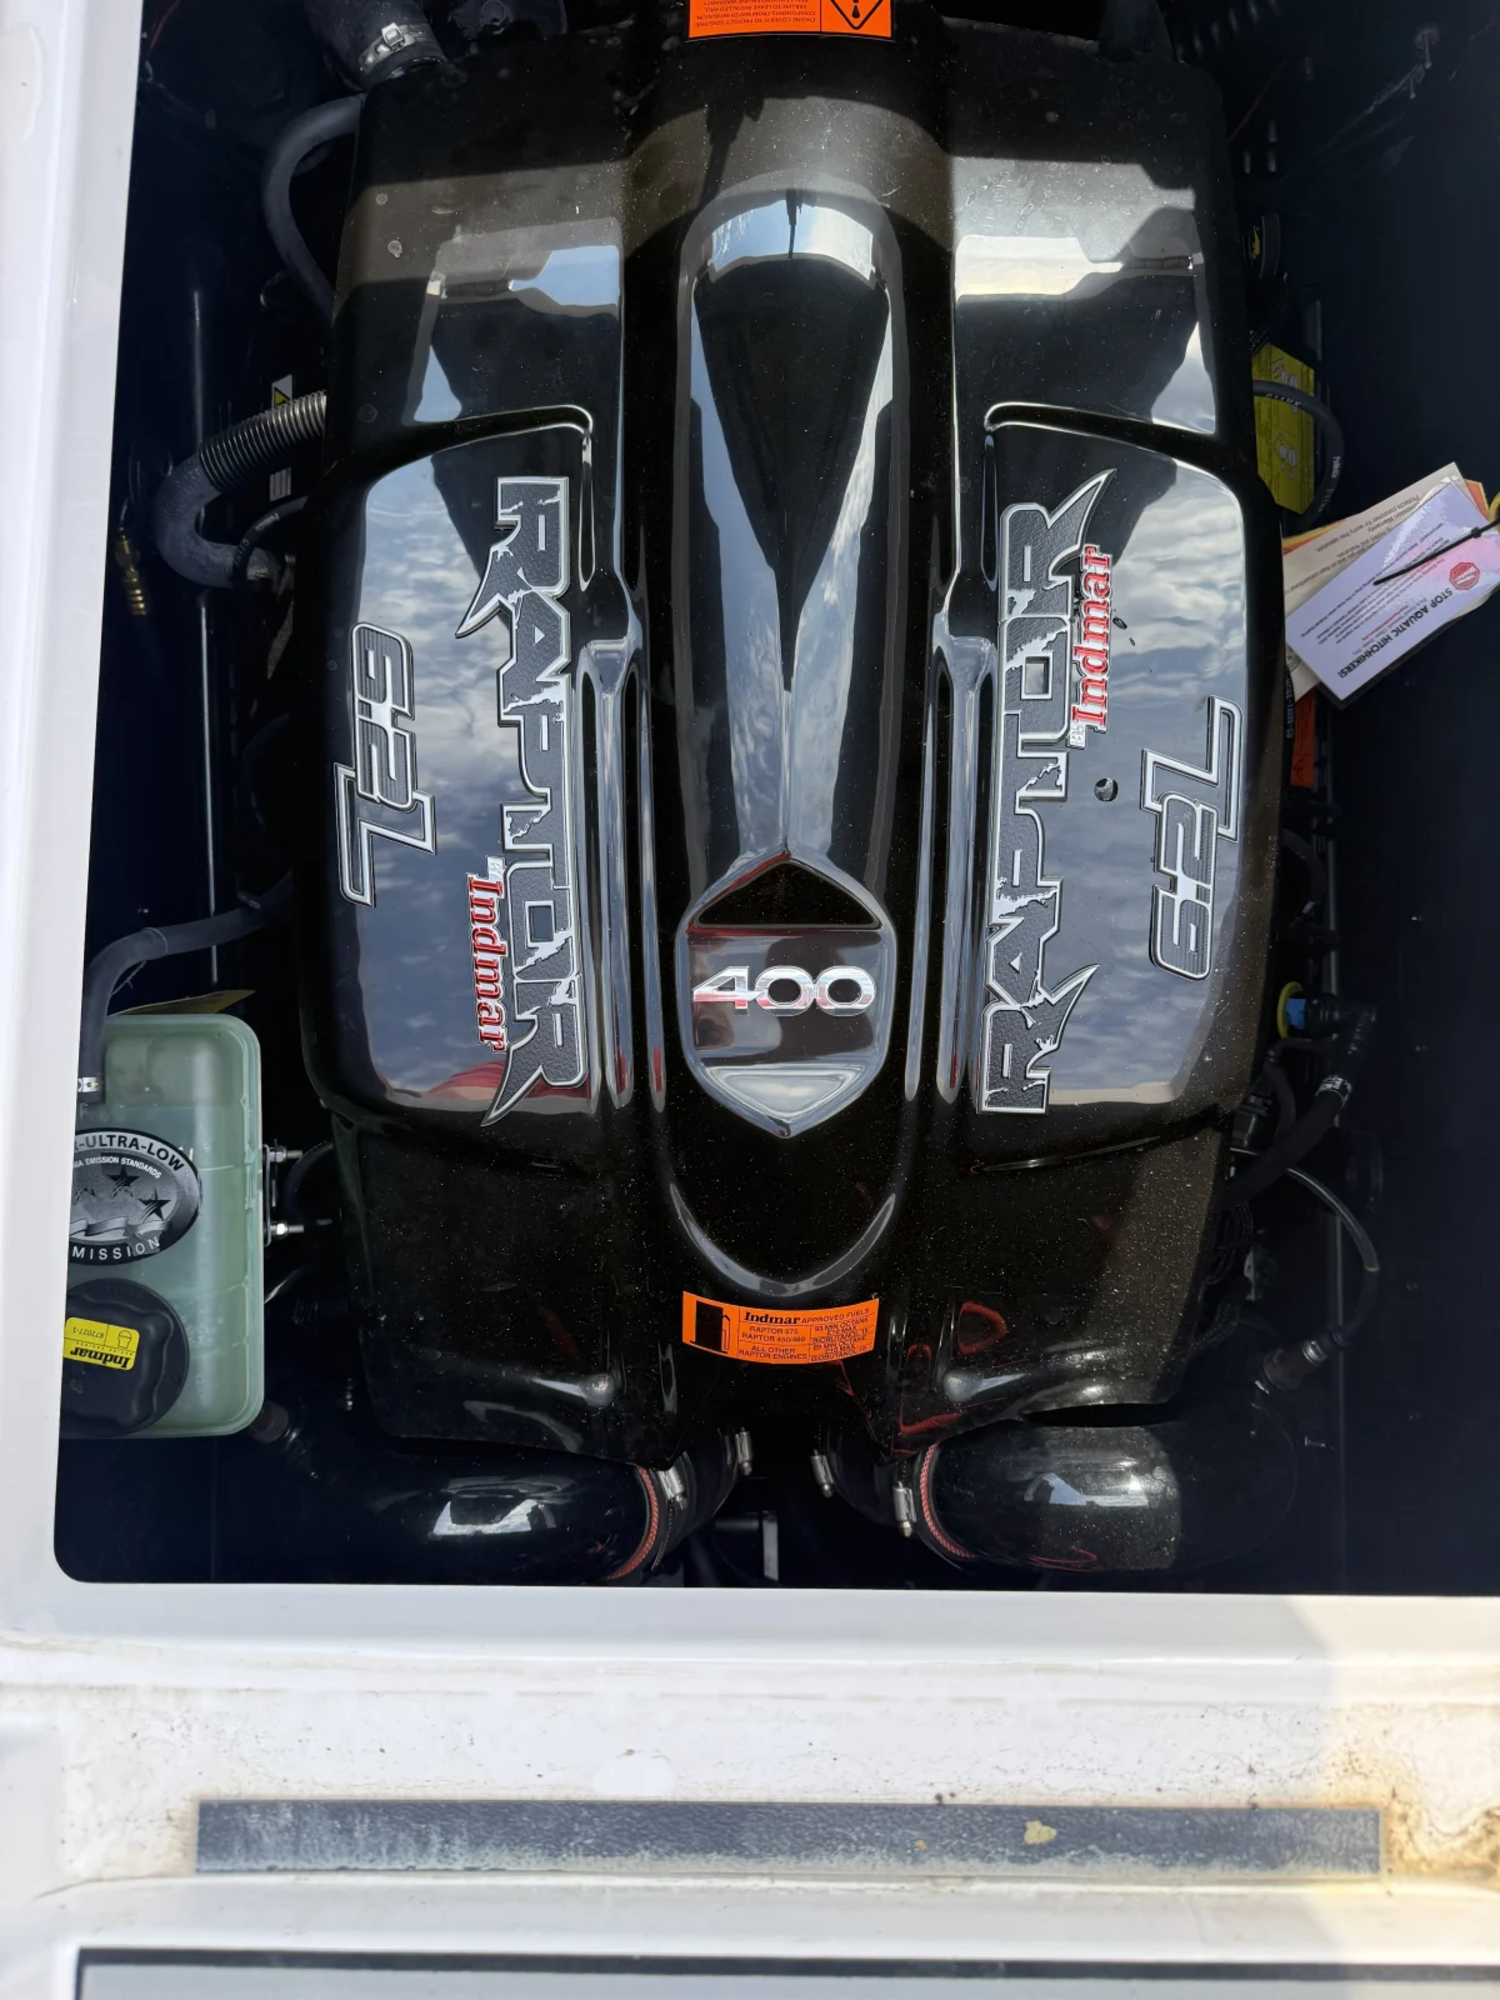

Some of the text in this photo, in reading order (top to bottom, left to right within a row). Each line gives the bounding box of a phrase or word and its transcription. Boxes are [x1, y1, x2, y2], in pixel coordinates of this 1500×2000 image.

[1430, 588, 1453, 609] STOP
[1391, 605, 1429, 637] AQUATIC
[1071, 545, 1112, 730] Indmar
[1337, 636, 1393, 679] HITCHHIKERS!
[456, 476, 587, 1126] RAPTOR
[977, 468, 1116, 1114] RAPTOR
[467, 872, 508, 1053] Indmar
[692, 965, 876, 1016] 400
[74, 1134, 184, 1171] -ULTRA-LOW
[85, 1156, 119, 1165] EMISSION
[120, 1156, 161, 1178] STANDARDS
[744, 1308, 870, 1324] Indmar APPROVED FUELS
[750, 1326, 783, 1334] RAPTOR
[742, 1332, 775, 1341] RAPTOR
[70, 1347, 130, 1368] Indmar
[739, 1350, 770, 1358] RAPTOR
